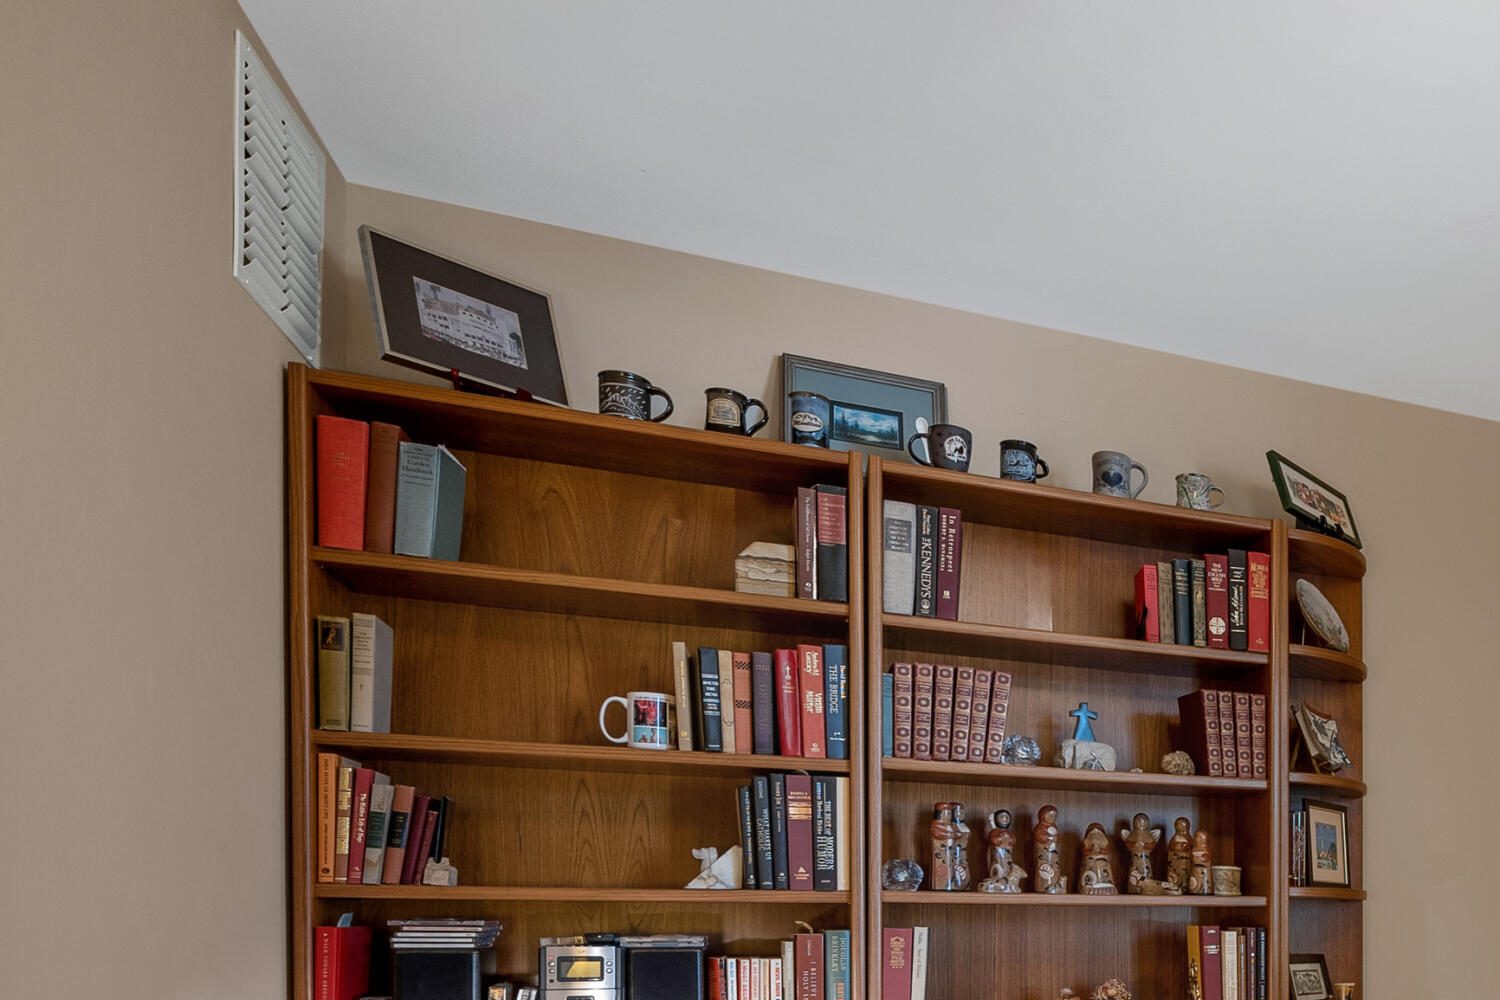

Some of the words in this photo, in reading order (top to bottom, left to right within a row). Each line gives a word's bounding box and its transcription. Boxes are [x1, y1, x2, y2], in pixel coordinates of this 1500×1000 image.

[948, 515, 957, 525] In
[946, 528, 957, 573] Retrospect
[921, 542, 932, 598] KENNEDYS
[829, 665, 838, 682] THE
[814, 692, 823, 713] Virgin
[829, 684, 838, 713] BRIDGE
[762, 808, 770, 828] WHAT
[816, 836, 825, 871] HUMOR
[825, 836, 834, 871] MODERN
[831, 935, 840, 973] BRINKLEY
[839, 937, 847, 971] DOUGLAS
[802, 970, 810, 990] HOLY
